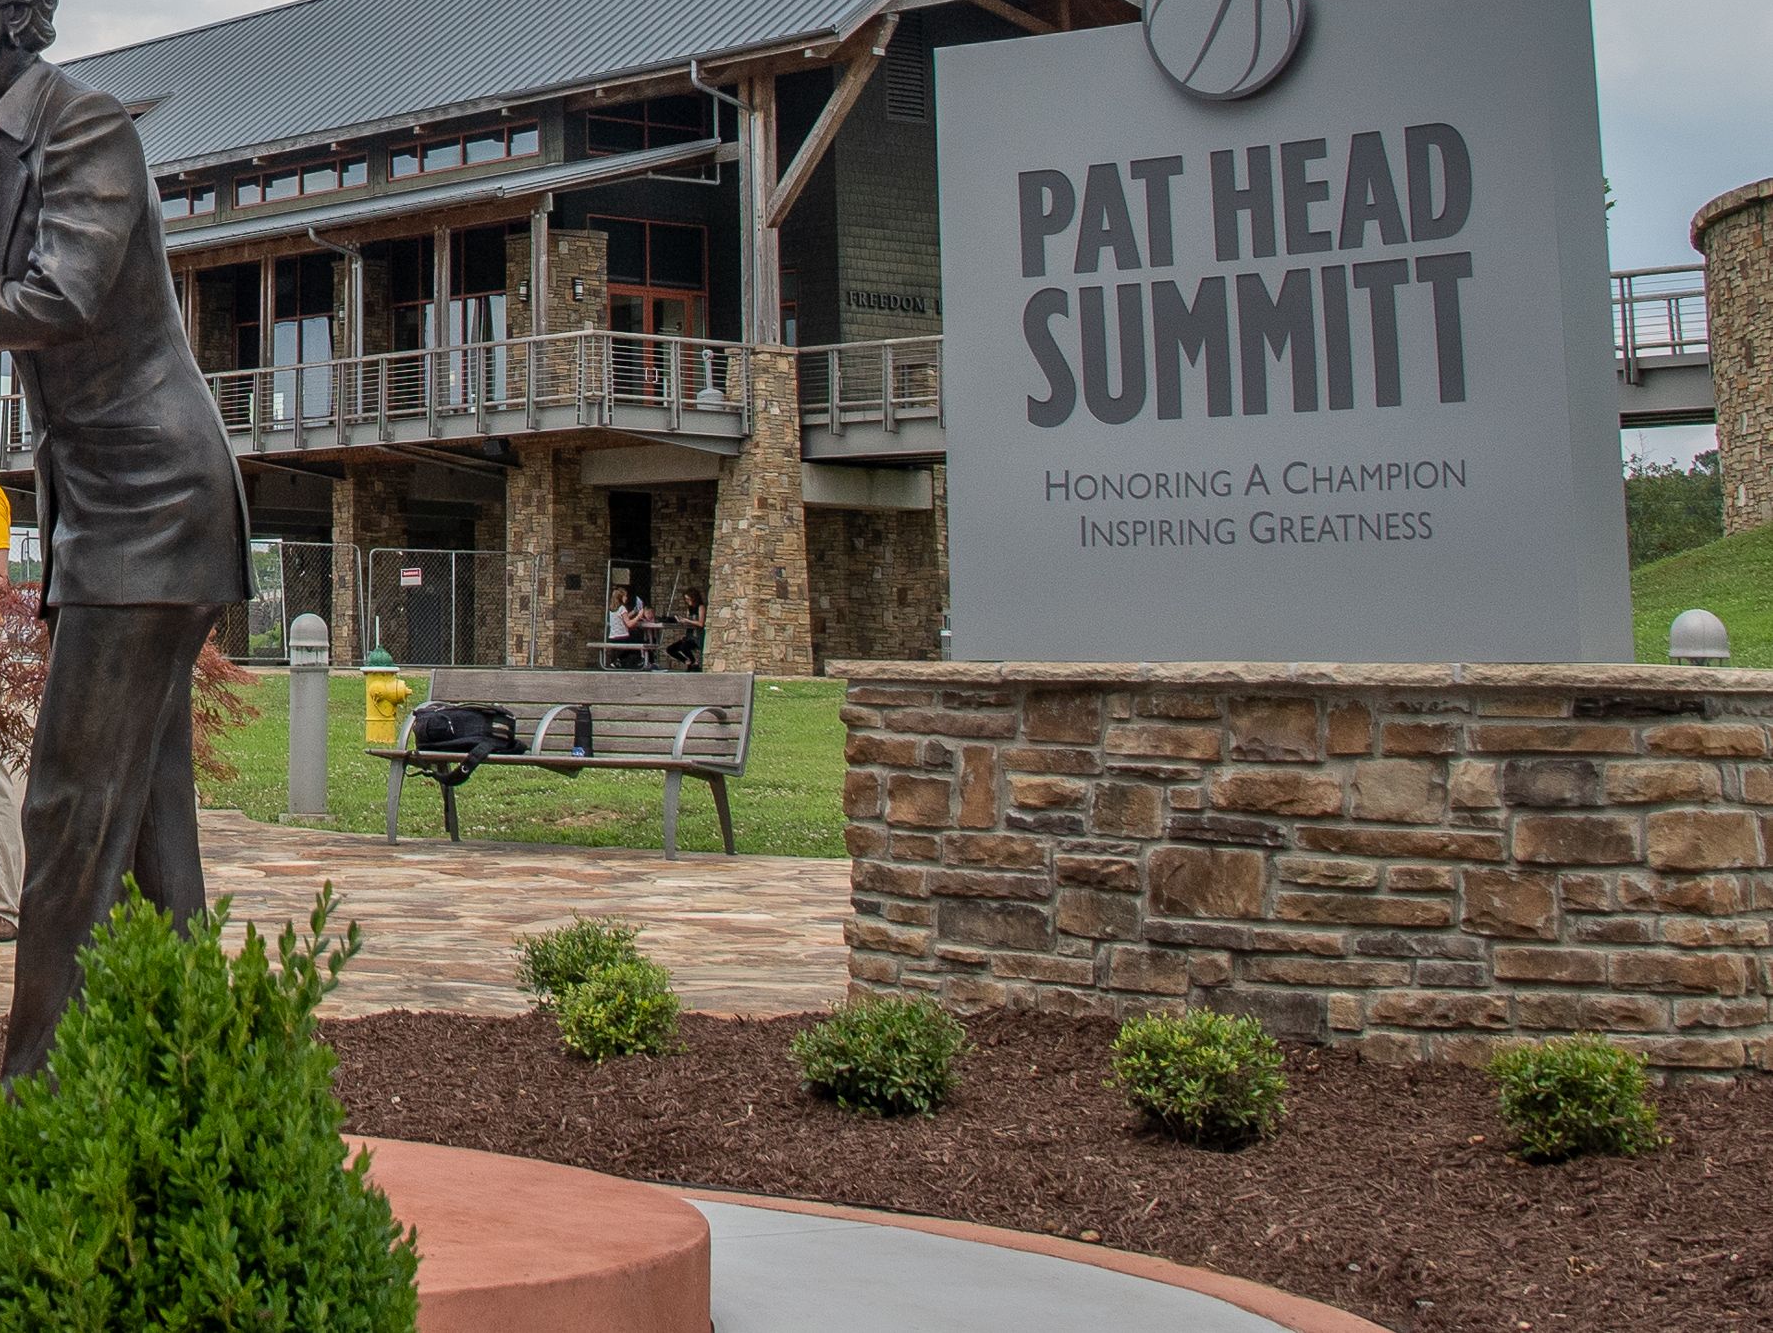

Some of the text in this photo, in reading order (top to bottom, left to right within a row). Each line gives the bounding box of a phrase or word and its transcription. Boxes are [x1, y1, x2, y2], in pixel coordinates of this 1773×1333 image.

[1018, 122, 1472, 278] PAT HEAD
[849, 290, 927, 313] FREEDOM
[1022, 251, 1473, 428] SUMMITT
[1044, 460, 1467, 501] HONORING A CHAMPION
[1080, 511, 1433, 548] INSPIRING GREATNESS
